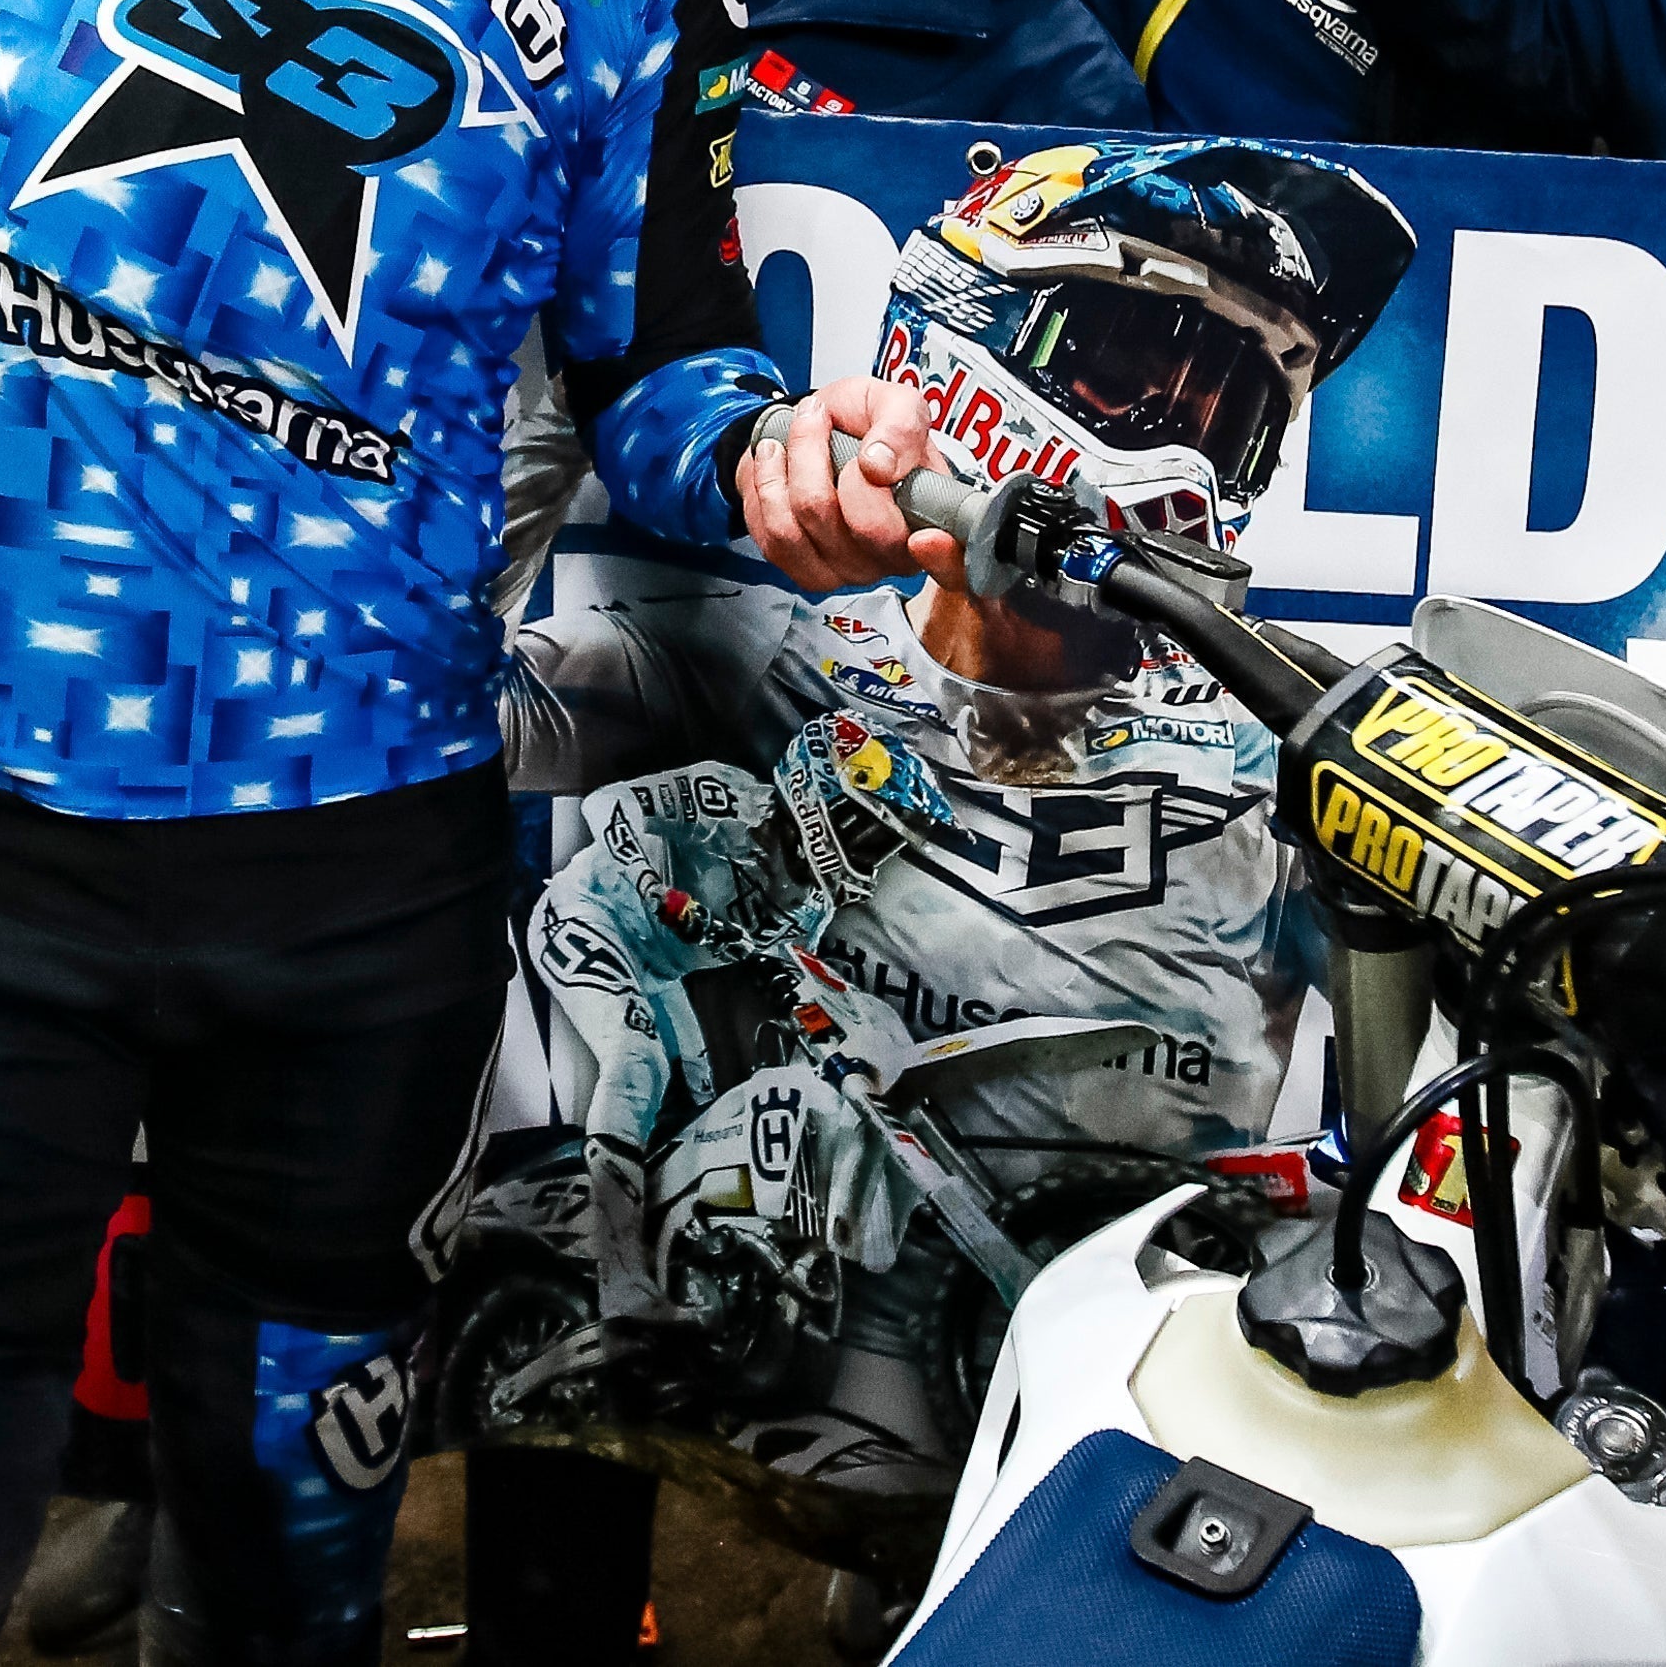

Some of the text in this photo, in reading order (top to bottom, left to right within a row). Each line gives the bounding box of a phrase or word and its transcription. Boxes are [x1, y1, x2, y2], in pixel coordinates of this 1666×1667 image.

[745, 78, 795, 113] FACTORY
[953, 385, 1081, 484] Bull
[1131, 717, 1235, 746] MOTOR
[1369, 687, 1649, 877] PROTAPER
[1317, 783, 1535, 942] PROTAP
